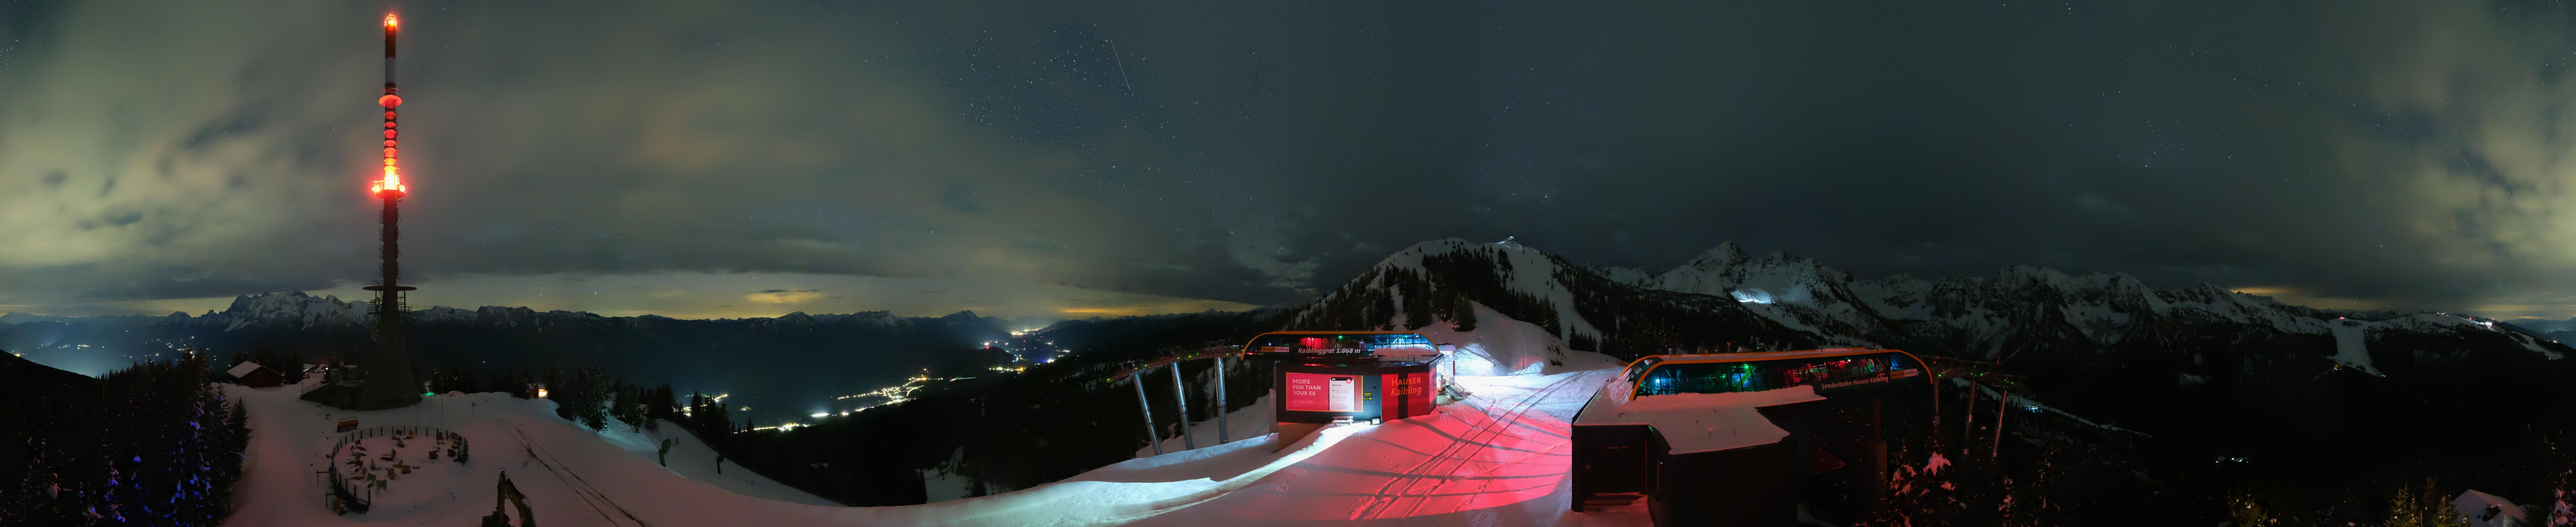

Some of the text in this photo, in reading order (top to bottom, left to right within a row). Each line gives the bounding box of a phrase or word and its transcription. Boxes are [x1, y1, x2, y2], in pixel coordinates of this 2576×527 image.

[1392, 377, 1421, 386] HAUSER
[1821, 380, 1852, 389] Senderbahn
[1391, 386, 1421, 396] Kaibling
